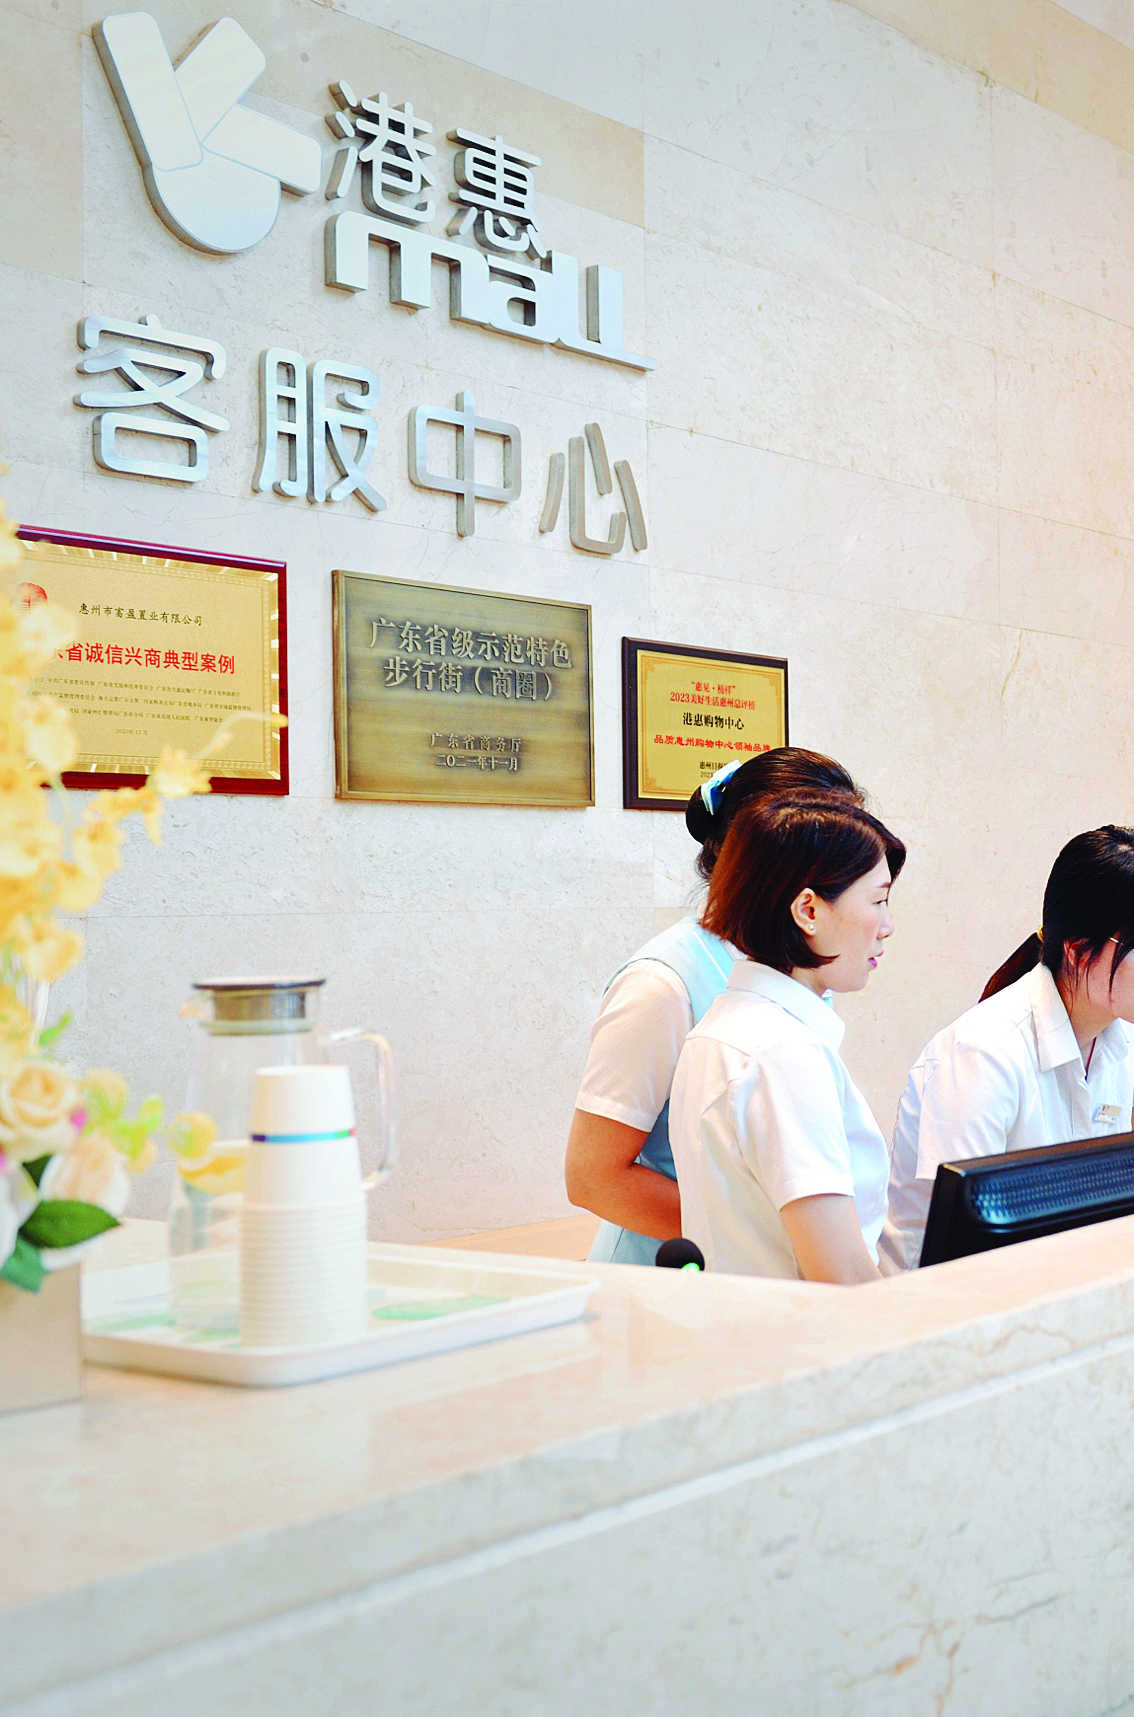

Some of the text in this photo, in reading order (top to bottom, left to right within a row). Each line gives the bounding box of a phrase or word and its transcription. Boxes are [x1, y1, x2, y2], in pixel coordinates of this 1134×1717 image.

[325, 80, 542, 260] 港惠
[73, 313, 648, 556] 客服中心
[369, 617, 573, 670] 广东省级示范特色
[670, 692, 756, 711] 2023美好生活惠州总评榜
[683, 712, 745, 730] 港惠购物中心
[430, 732, 522, 753] 广东省商务厅
[654, 734, 771, 752] 品质惠州购物中心领袖品牌
